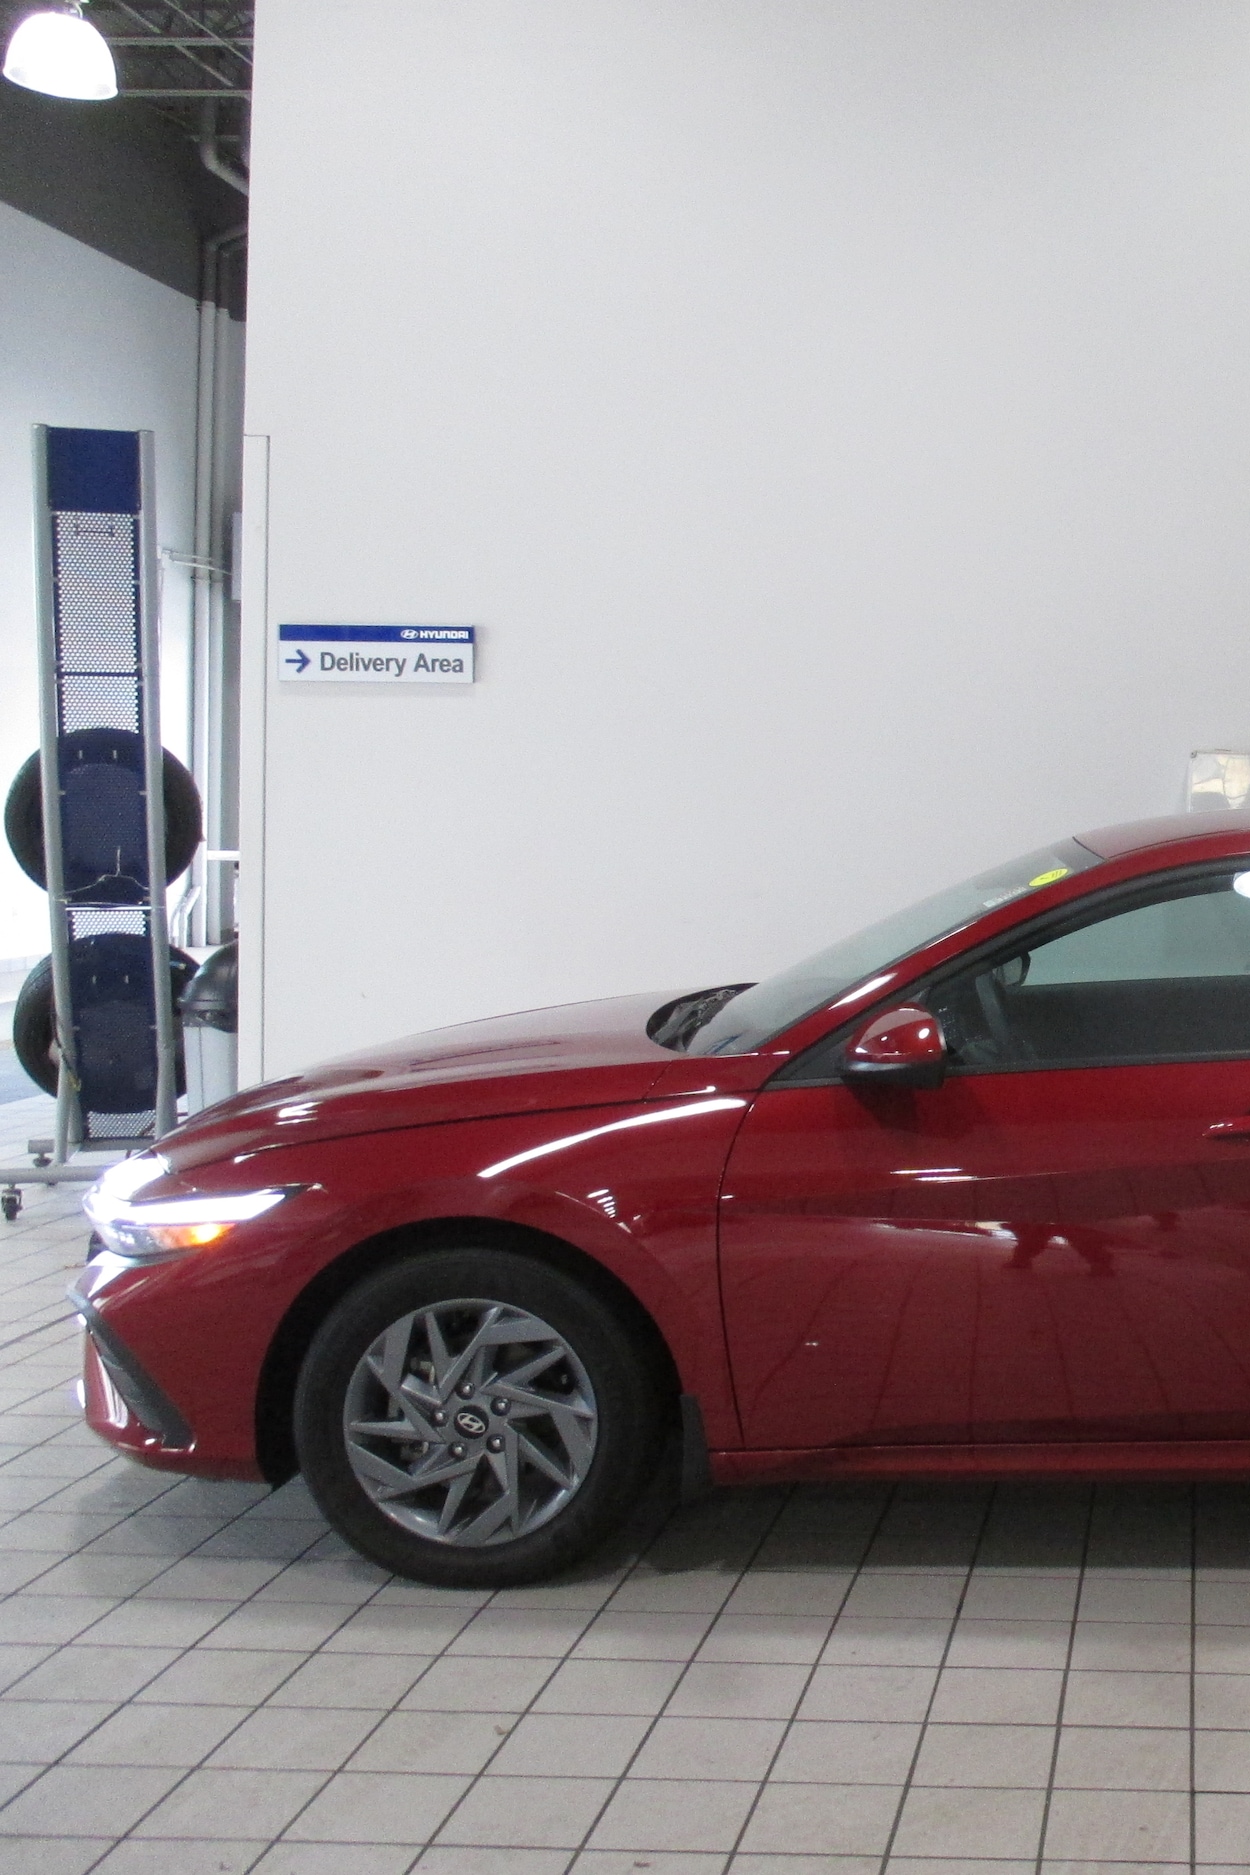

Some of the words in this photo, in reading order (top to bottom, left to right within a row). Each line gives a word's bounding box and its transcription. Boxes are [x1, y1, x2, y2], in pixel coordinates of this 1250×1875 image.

[420, 630, 469, 639] HYUNDAI
[320, 652, 407, 677] Delivery
[413, 653, 464, 673] Area
